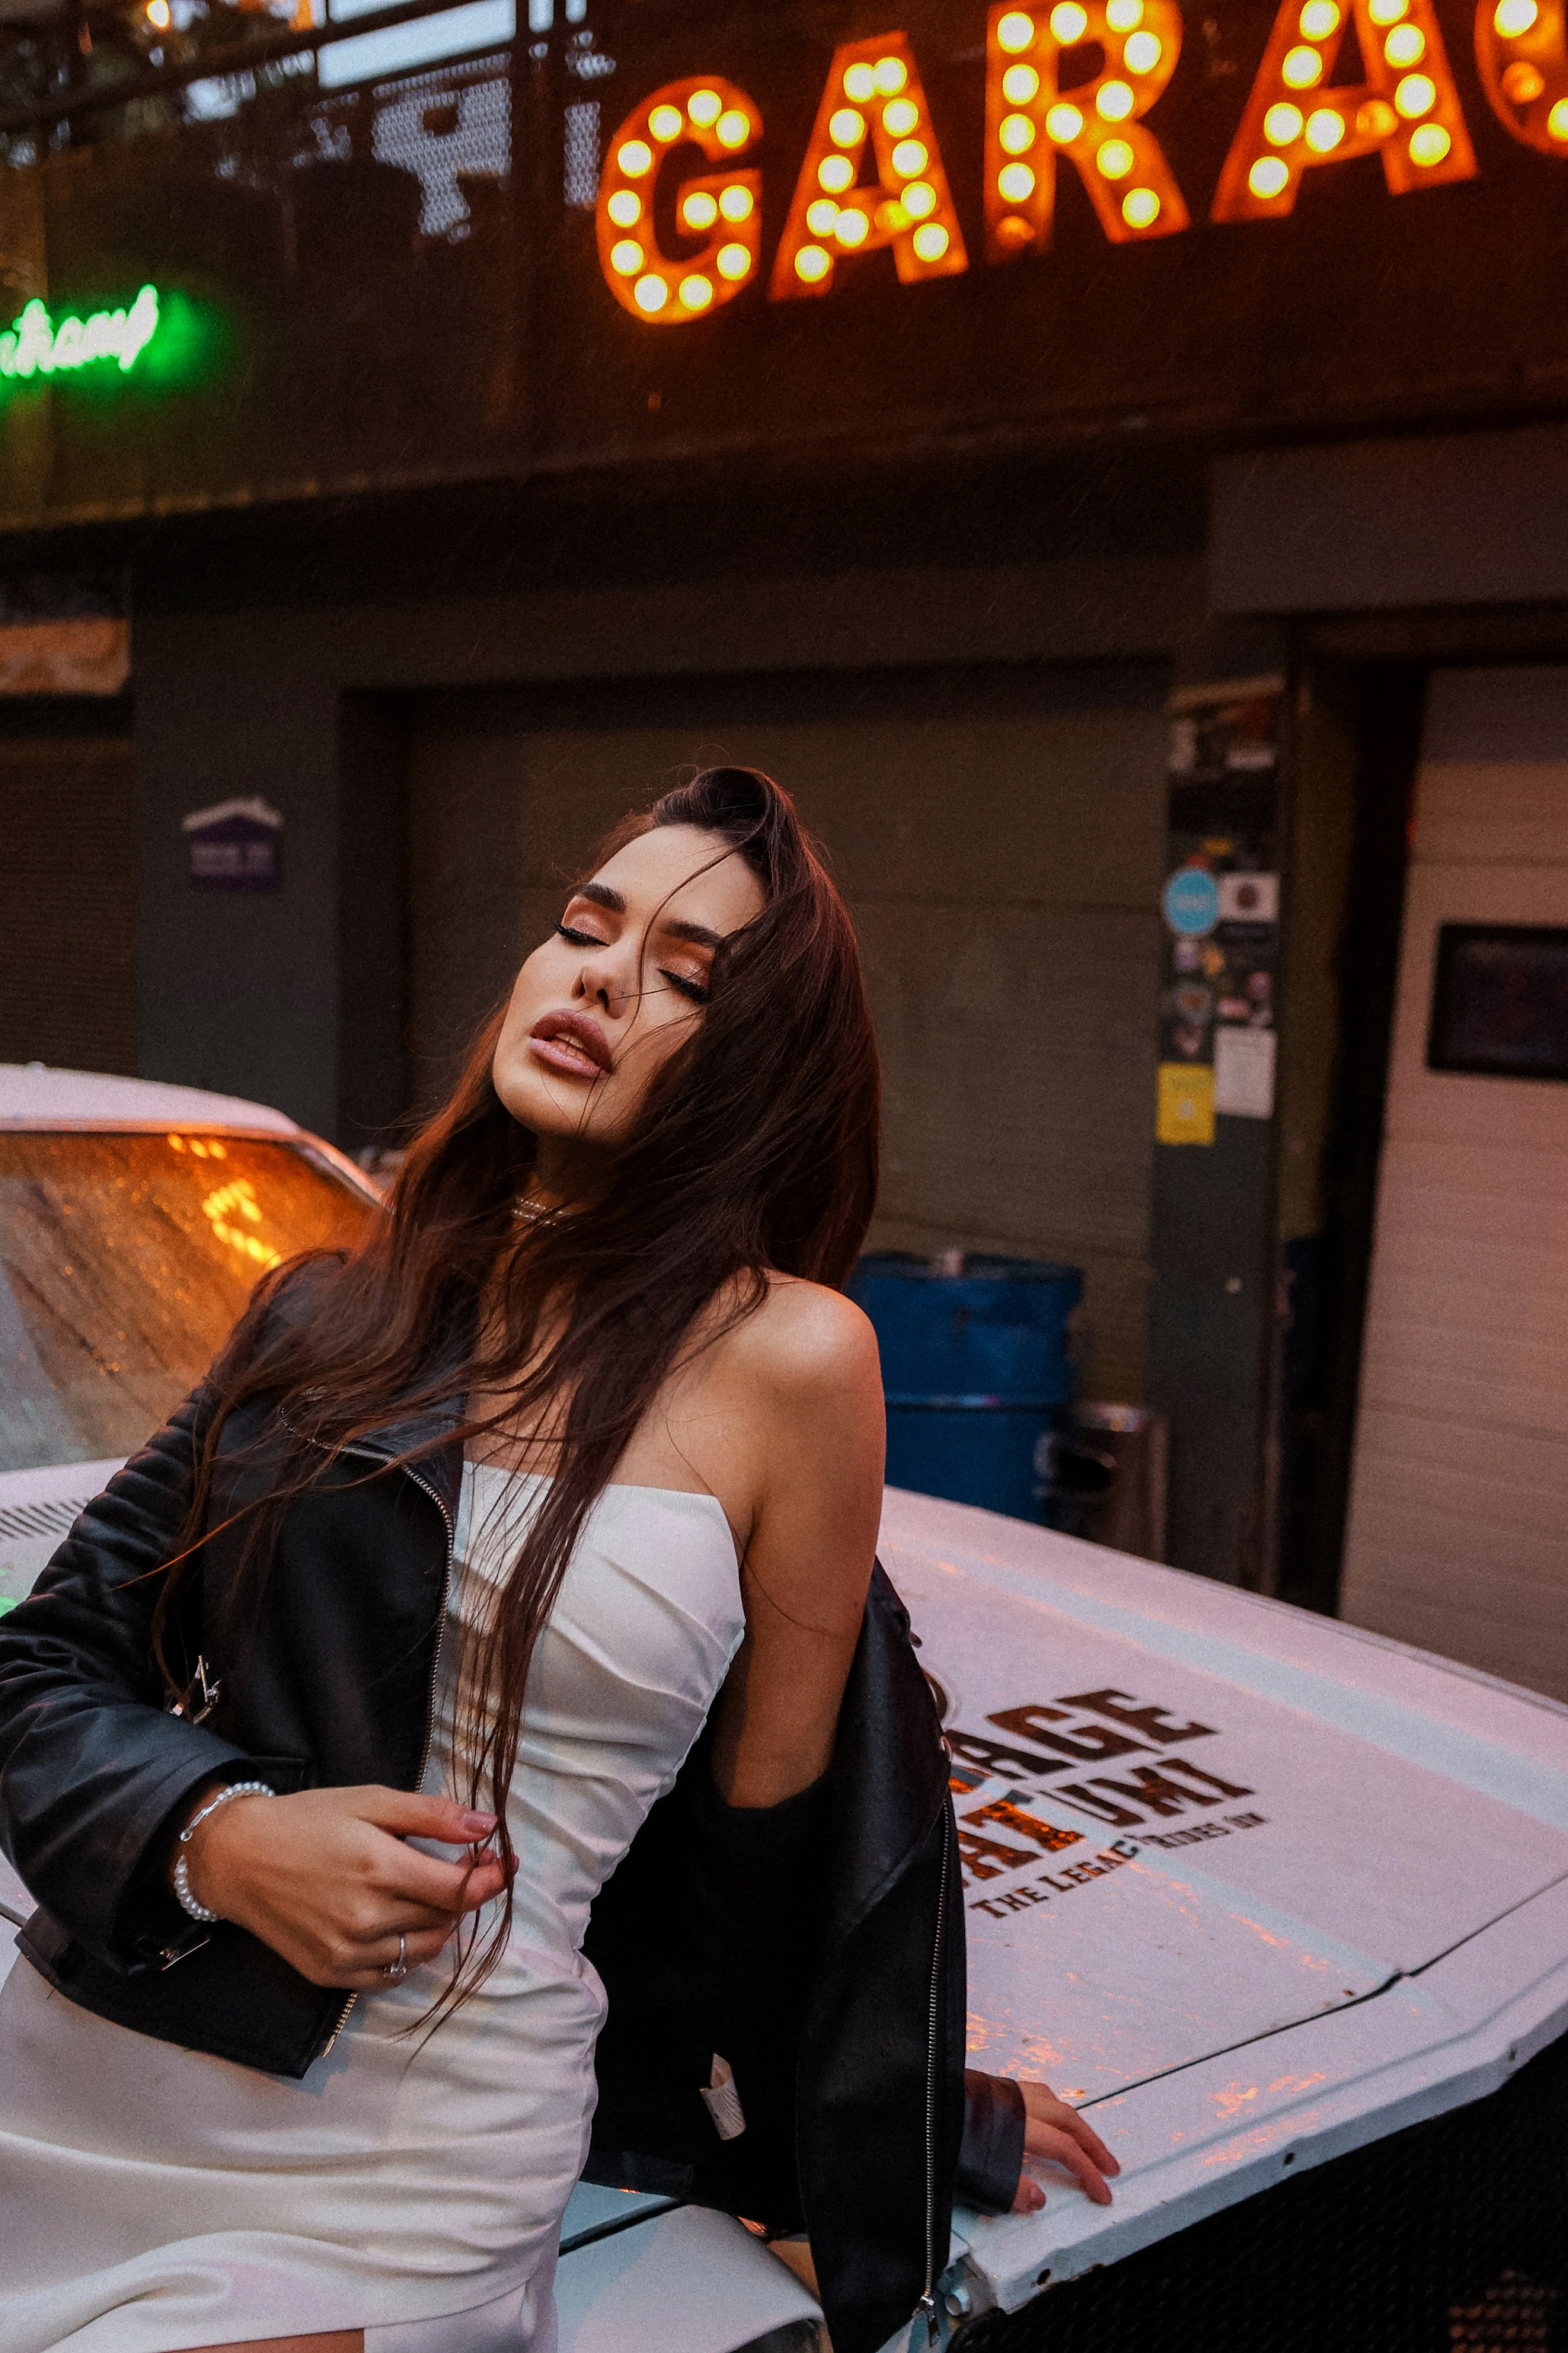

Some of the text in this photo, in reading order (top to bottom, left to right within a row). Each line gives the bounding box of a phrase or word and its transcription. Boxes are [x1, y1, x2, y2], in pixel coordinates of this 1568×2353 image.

[944, 1689, 1220, 1795] AGE
[957, 1758, 1256, 1888] ATUMI
[969, 1887, 1049, 1919] THE
